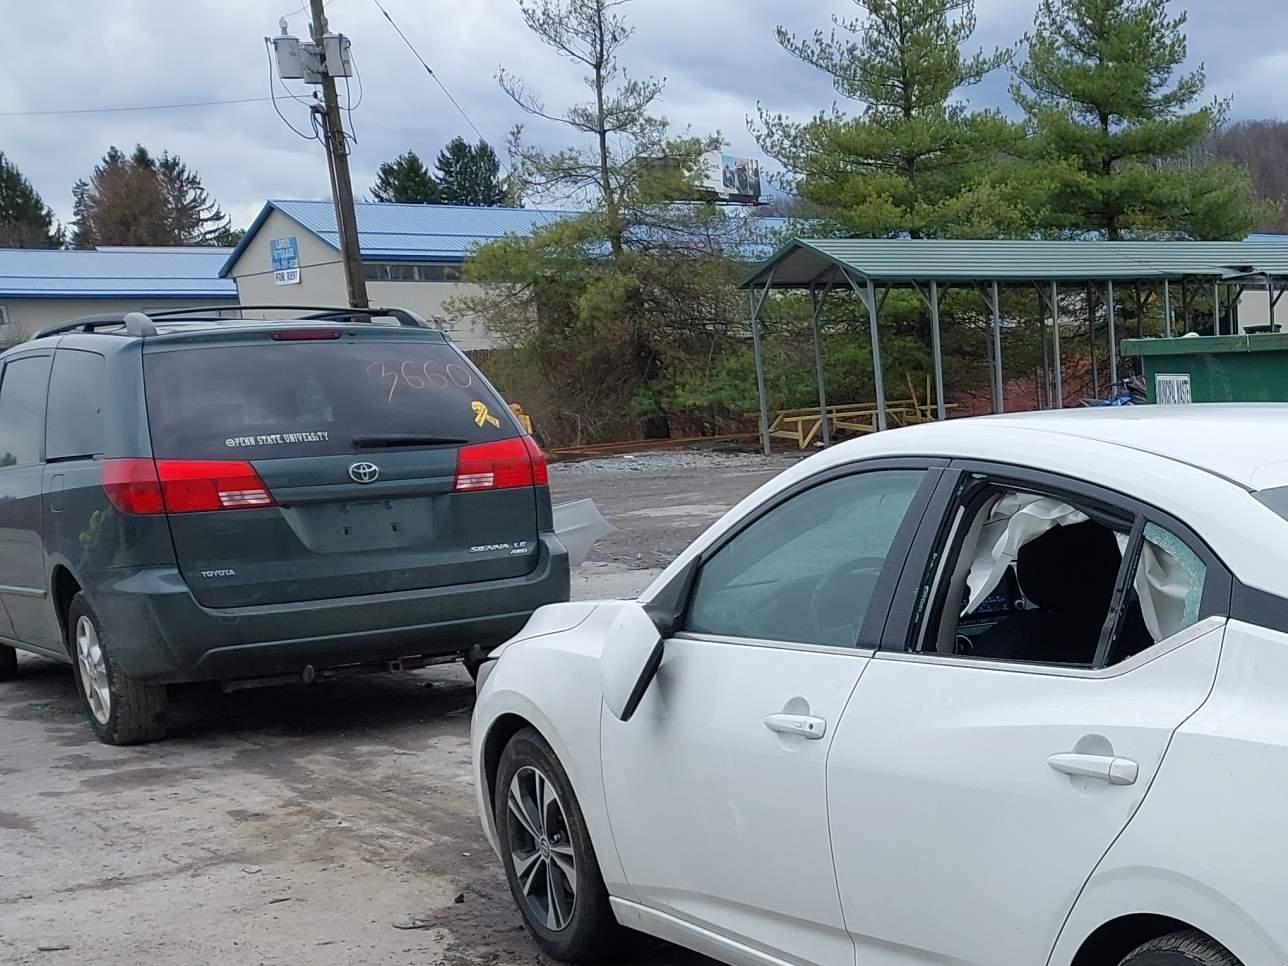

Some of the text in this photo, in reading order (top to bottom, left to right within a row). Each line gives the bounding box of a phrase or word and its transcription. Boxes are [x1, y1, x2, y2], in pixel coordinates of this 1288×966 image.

[235, 431, 329, 446] PENN STATE UNIVERSITY
[469, 543, 509, 553] SIENNA
[200, 569, 236, 578] TOYOTA
